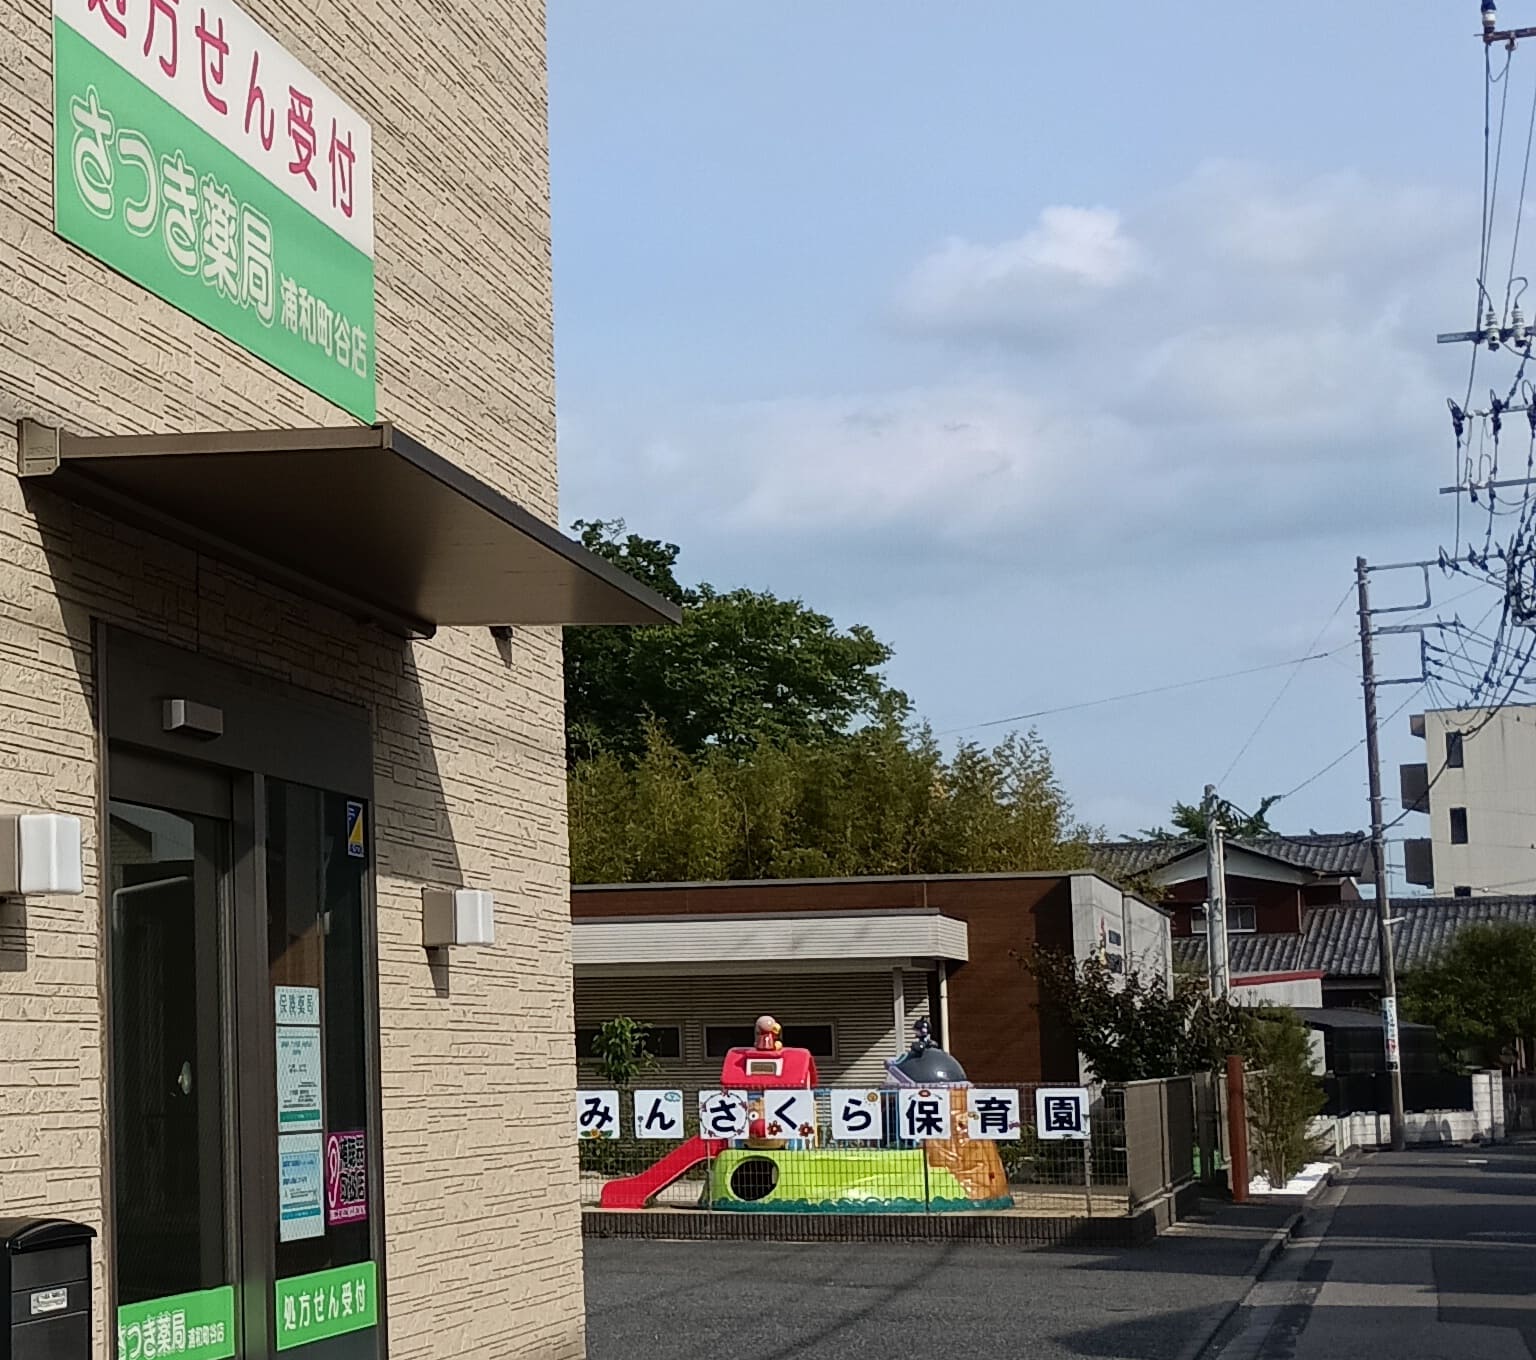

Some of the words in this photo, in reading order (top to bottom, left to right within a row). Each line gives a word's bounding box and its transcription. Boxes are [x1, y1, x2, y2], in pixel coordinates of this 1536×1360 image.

[69, 84, 276, 329] さつき薬局
[280, 272, 368, 379] 浦和町谷店
[578, 1094, 1083, 1135] みんさくら保育園
[283, 1278, 367, 1332] 処方せん受付
